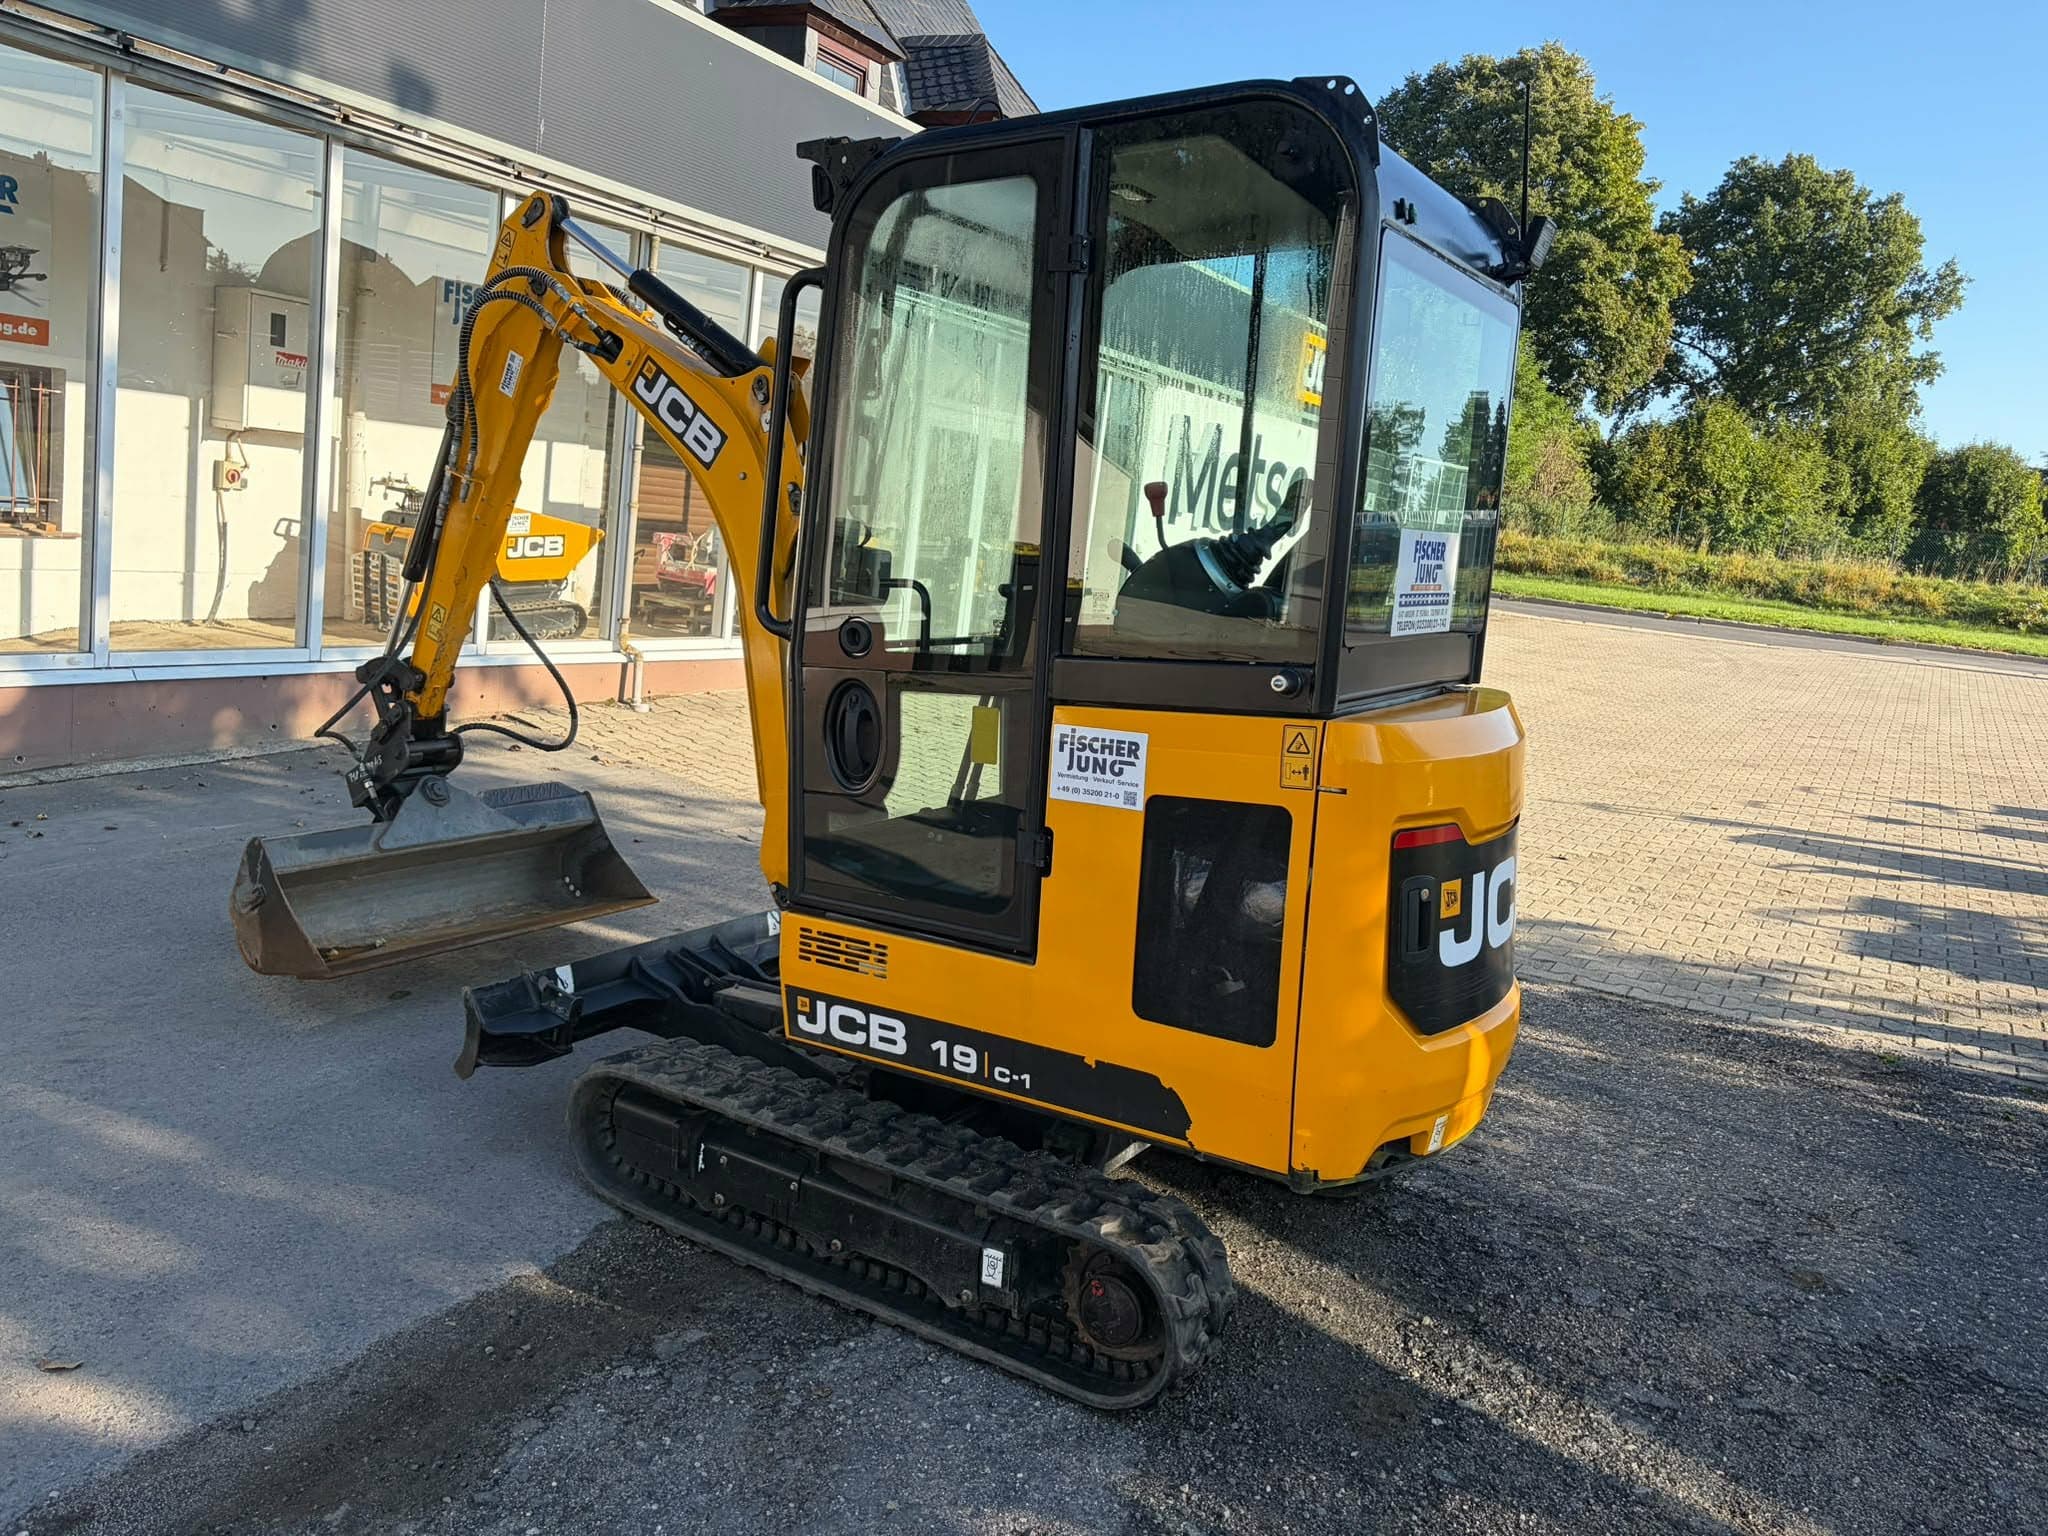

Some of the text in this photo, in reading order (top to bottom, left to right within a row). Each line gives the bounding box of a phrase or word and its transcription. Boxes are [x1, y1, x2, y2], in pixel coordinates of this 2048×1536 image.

[635, 374, 722, 463] JCB
[507, 535, 564, 558] JCB
[1057, 771, 1139, 788] Vermietung Verkauf Service
[1056, 785, 1120, 800] +49 (0) 35200 21-0
[797, 999, 907, 1055] JCB
[930, 1039, 977, 1074] 19
[994, 1066, 1031, 1089] C-1
